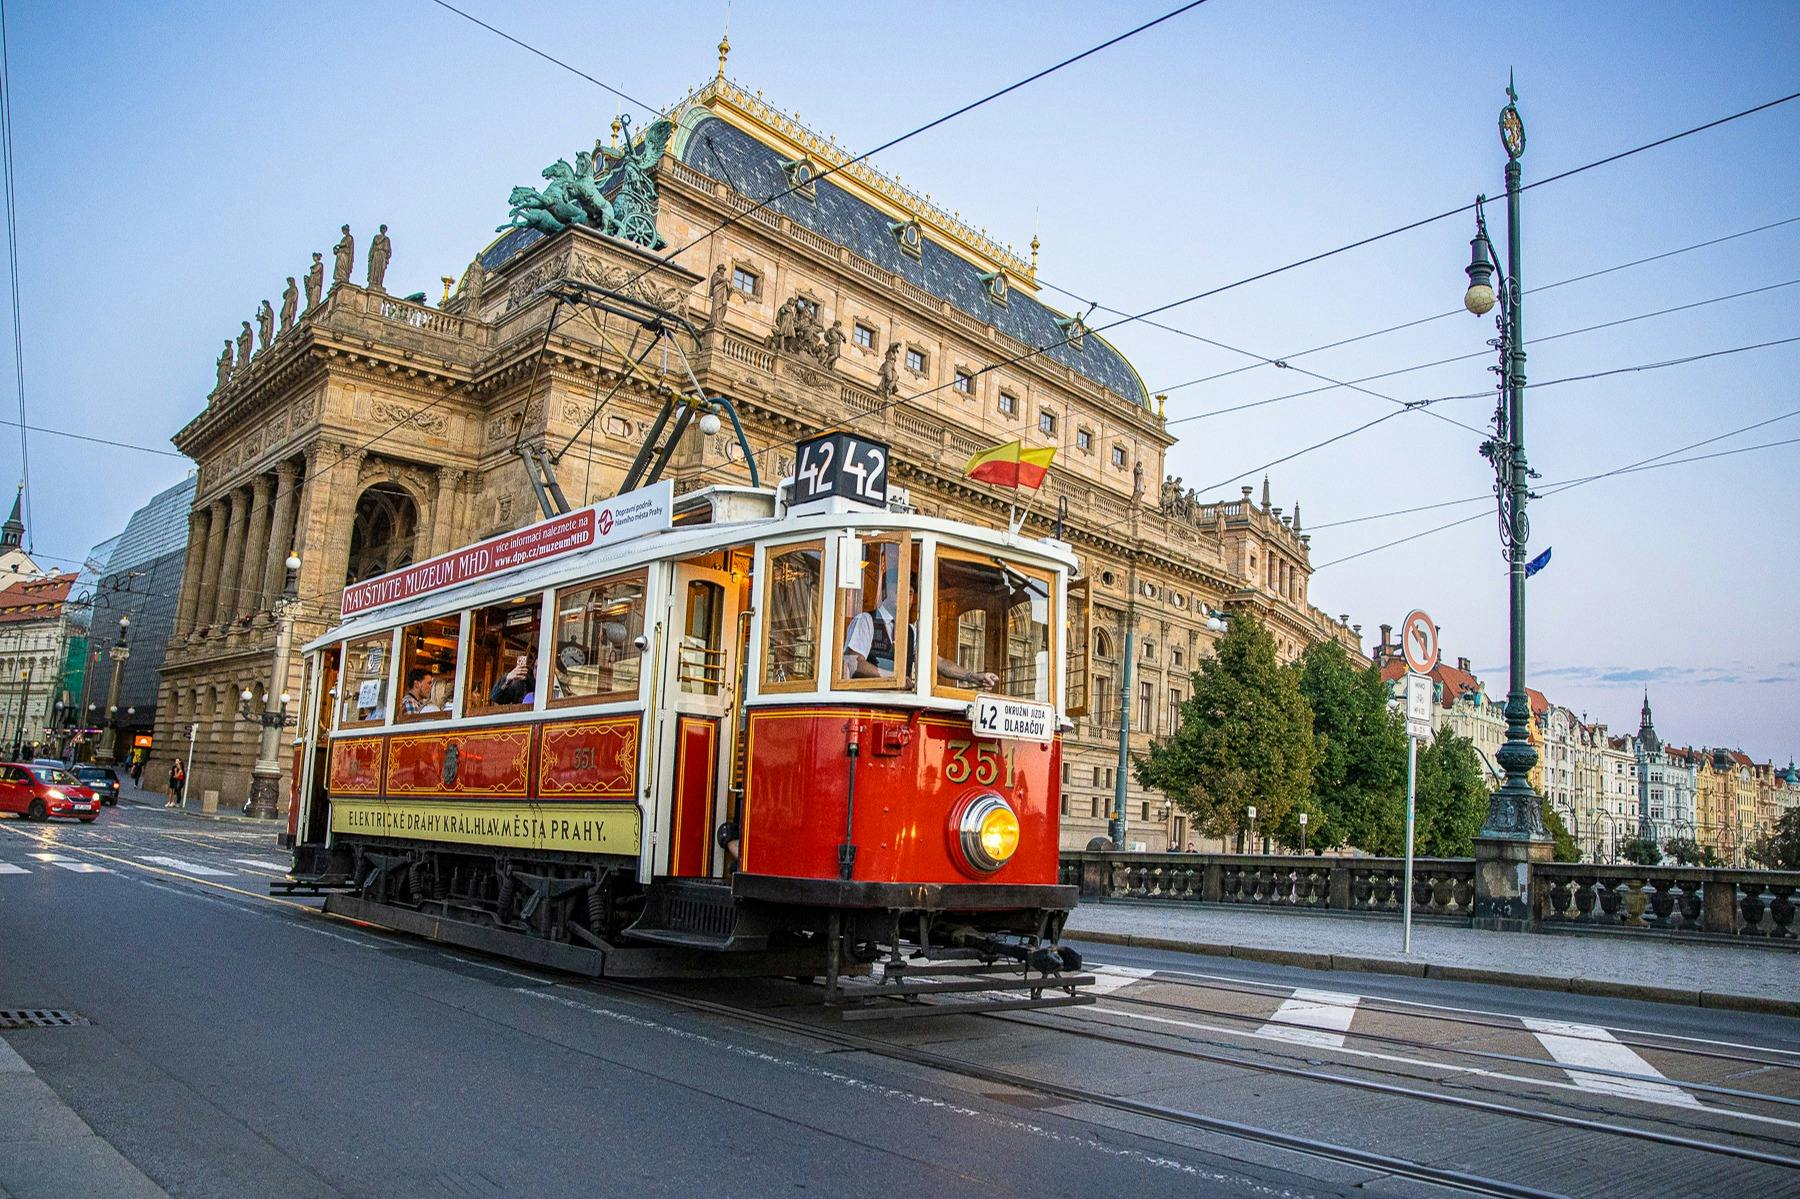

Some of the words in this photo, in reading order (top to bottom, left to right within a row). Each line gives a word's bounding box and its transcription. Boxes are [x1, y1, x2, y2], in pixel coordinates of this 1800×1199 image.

[798, 442, 834, 496] 42
[843, 440, 885, 501] 42
[615, 504, 636, 517] Dopravní
[636, 499, 652, 512] podnik
[615, 514, 634, 527] hlavního
[635, 511, 648, 522] města
[649, 507, 663, 518] Prahy
[495, 531, 589, 567] www.dpp.cz/muzeumMHD
[496, 541, 509, 553] více
[510, 530, 541, 548] informací
[543, 520, 576, 539] naleznete
[578, 516, 588, 527] na
[345, 577, 402, 612] NAVŠTIVTE
[405, 559, 455, 594] MUZEUM
[458, 549, 489, 579] MHD
[979, 704, 998, 730] 42
[1004, 705, 1029, 717] OKRUŽNÍ
[1031, 706, 1046, 719] JÍZDA
[1004, 717, 1045, 736] DLABAČOV
[574, 747, 595, 769] 351
[945, 740, 1015, 789] 351
[348, 810, 405, 829] ELEKTRICKÉ
[408, 812, 441, 832] DRÁHY
[551, 820, 606, 842] PRAHY.
